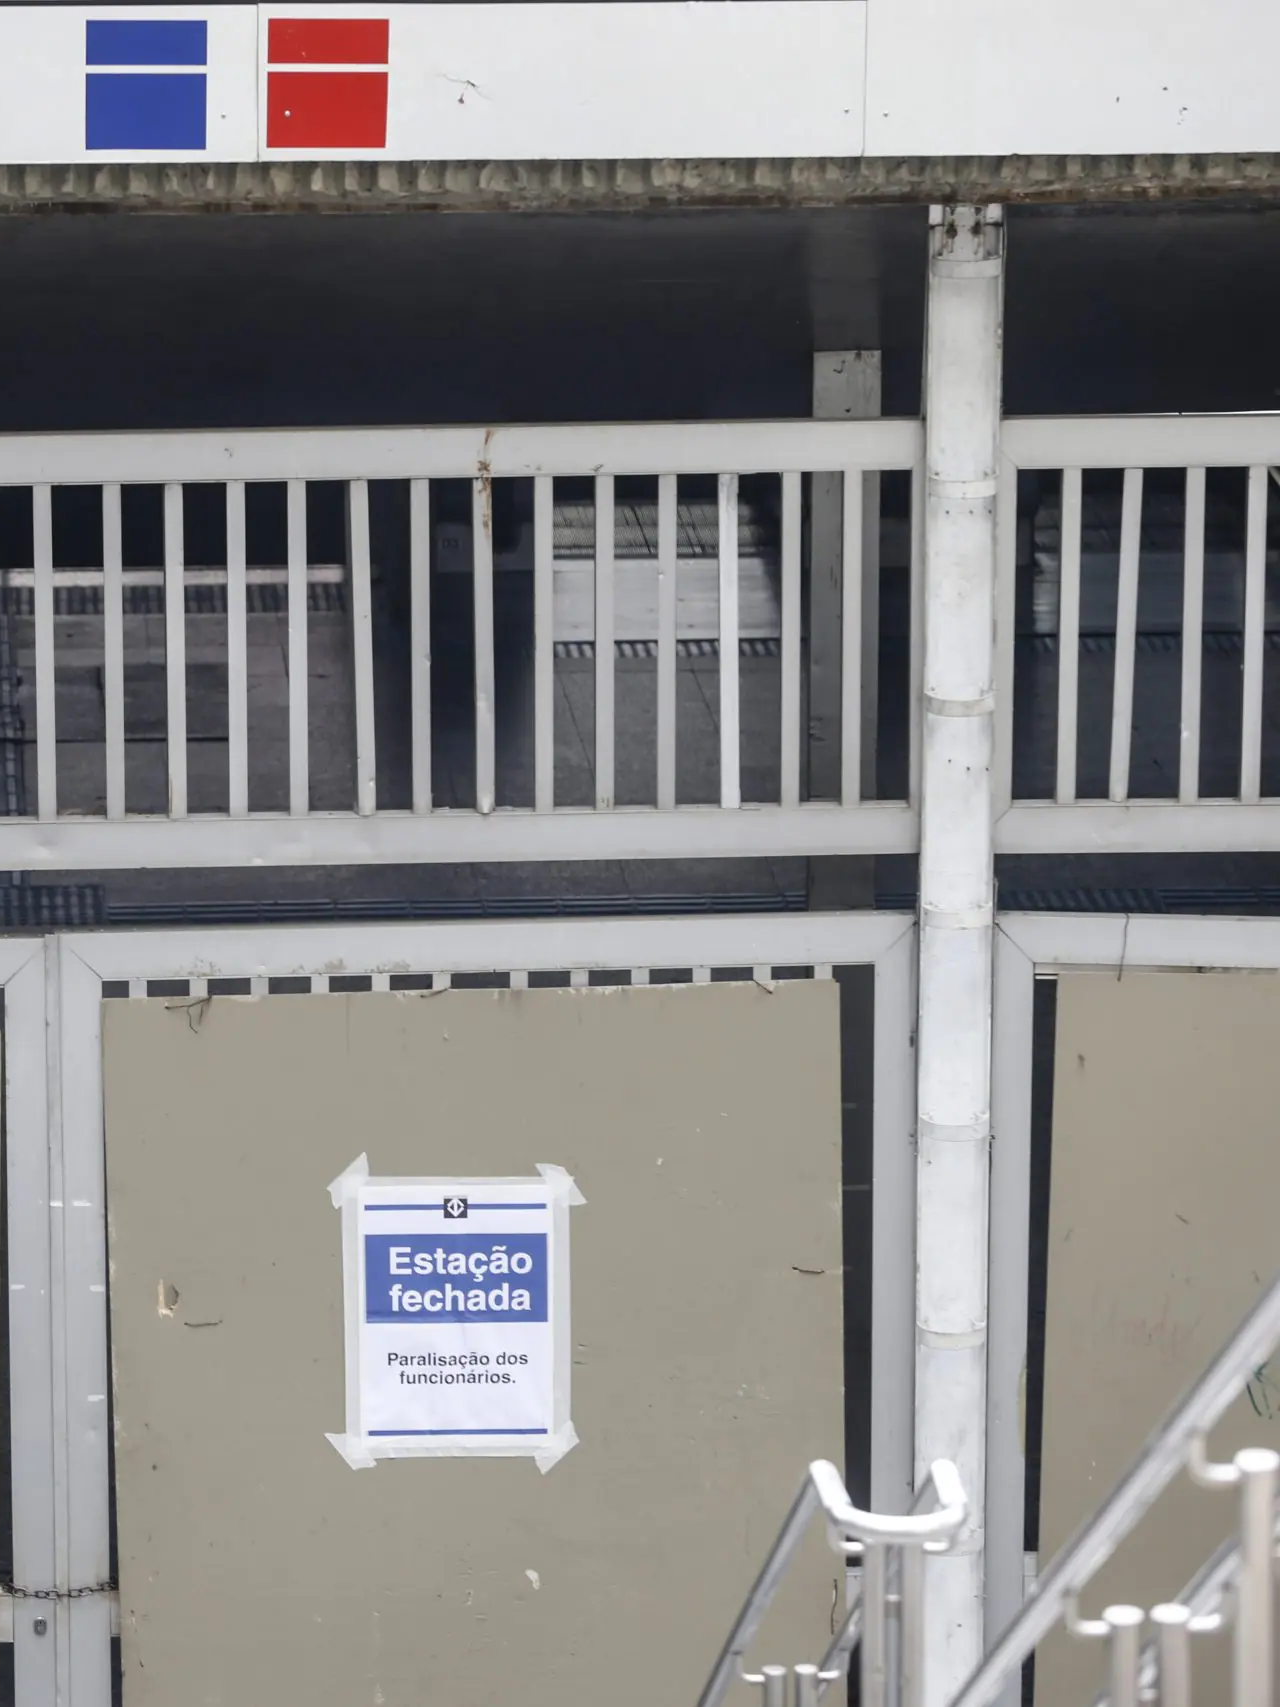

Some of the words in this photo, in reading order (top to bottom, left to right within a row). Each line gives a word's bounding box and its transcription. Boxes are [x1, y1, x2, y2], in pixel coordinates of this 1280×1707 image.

[389, 1245, 533, 1283] Estação
[388, 1282, 532, 1312] fechada
[387, 1351, 490, 1370] Paralisação
[496, 1351, 528, 1366] dos
[399, 1370, 516, 1385] funcionários.
